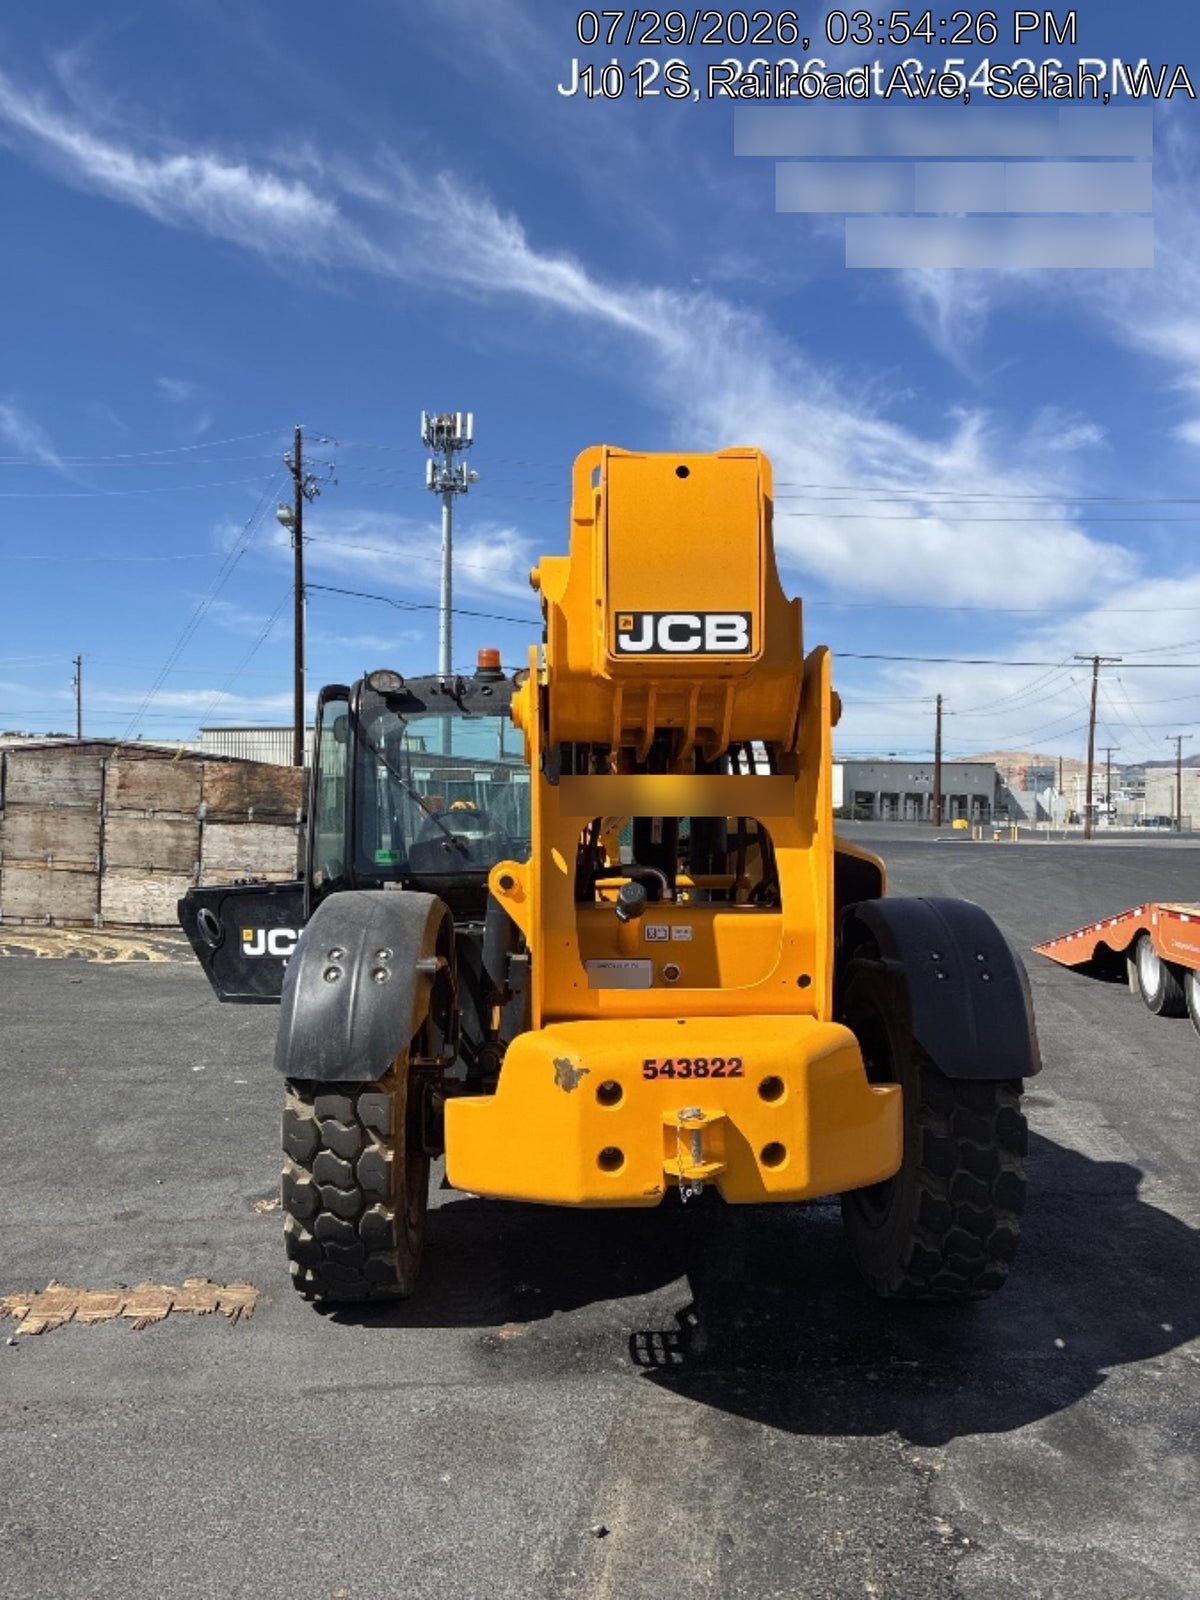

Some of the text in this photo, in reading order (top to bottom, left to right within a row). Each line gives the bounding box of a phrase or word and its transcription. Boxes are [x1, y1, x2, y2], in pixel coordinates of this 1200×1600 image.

[617, 614, 750, 652] JCB
[242, 928, 304, 956] JC
[642, 1057, 744, 1080] 543822
